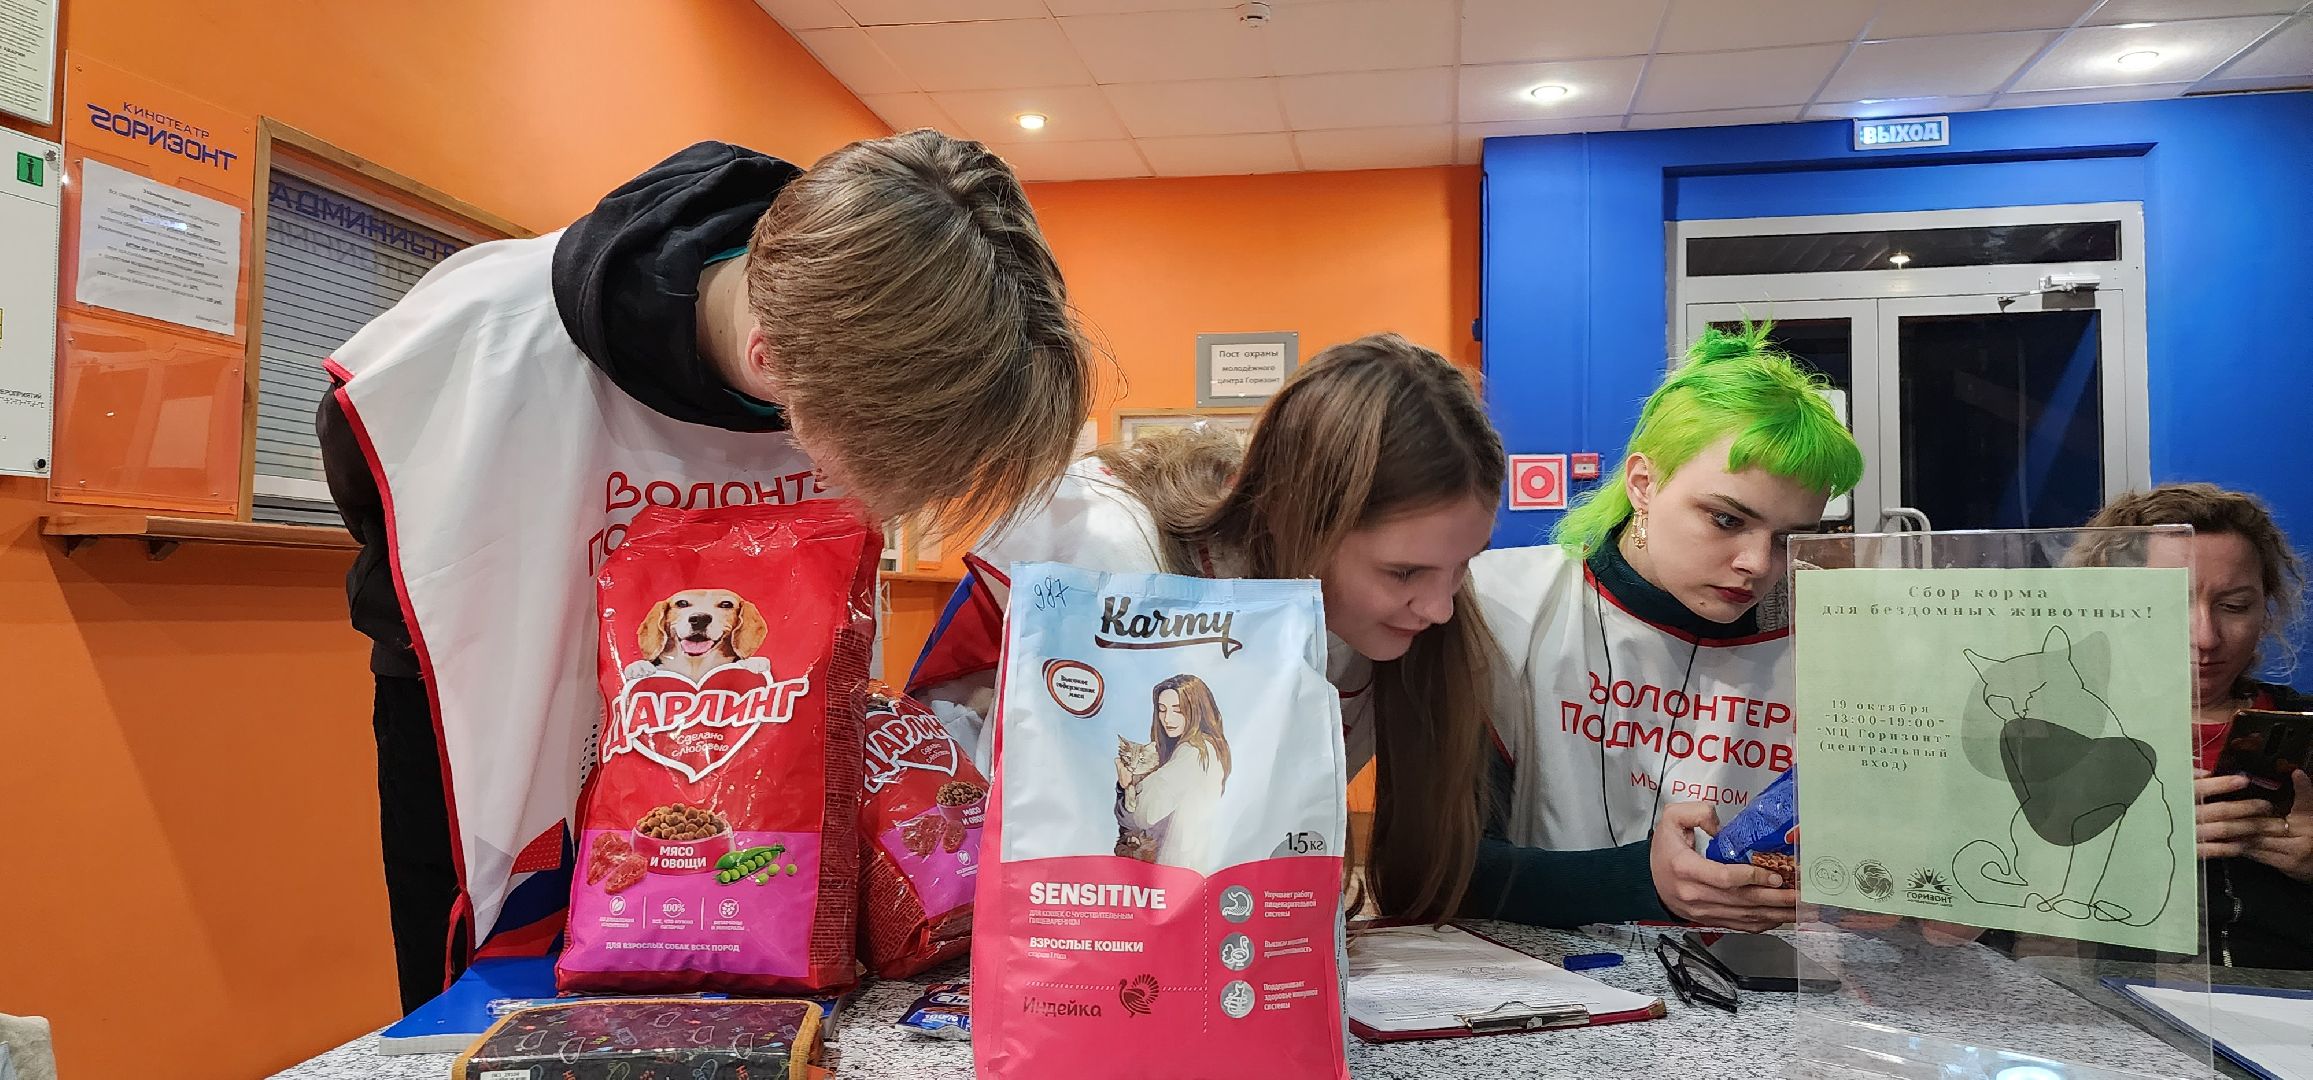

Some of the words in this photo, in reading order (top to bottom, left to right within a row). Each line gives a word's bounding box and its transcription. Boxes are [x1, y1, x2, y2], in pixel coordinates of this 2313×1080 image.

[123, 102, 209, 139] КИНОТЕАТР
[87, 103, 238, 170] ГОРИЗОНТ
[1863, 122, 1941, 144] ВЫХОД
[271, 182, 458, 260] АДМИНИСТР
[1219, 350, 1240, 358] Пост
[1244, 350, 1279, 359] охраны
[1217, 377, 1244, 385] центра
[1033, 576, 1069, 611] 987
[1908, 585, 1960, 600] Сбор
[1974, 588, 2048, 601] корма
[1822, 605, 1858, 616] для
[1870, 604, 1998, 618] бездомных
[2009, 606, 2153, 618] животных!
[1098, 596, 1238, 658] Karmy
[1588, 671, 1796, 734] ВОЛОНТЕР
[1831, 699, 1848, 709] 19
[1856, 703, 1930, 715] октября
[603, 676, 809, 763] ДАРЛИНГ
[1560, 700, 1793, 773] ПОДМОСКОВ
[1820, 741, 1947, 757] (центральный
[1861, 759, 1907, 772] вход)
[1672, 780, 1748, 806] РЯДОМ
[659, 845, 694, 856] МЯСО
[650, 856, 659, 866] И
[661, 857, 707, 868] ОВОЩИ
[1029, 882, 1167, 909] SENSITIVE
[1906, 891, 1952, 904] ГОРИЗОНТ
[662, 903, 686, 913] 100%
[605, 941, 621, 950] ДЛЯ
[622, 942, 664, 950] ВЗРОСЛЫХ
[691, 943, 711, 951] ВСЕХ
[711, 944, 740, 953] ПОРОД
[1029, 937, 1093, 951] ВЗРОСЛЫЕ
[1094, 940, 1144, 952] КОШКИ
[1023, 995, 1102, 1018] Индейка
